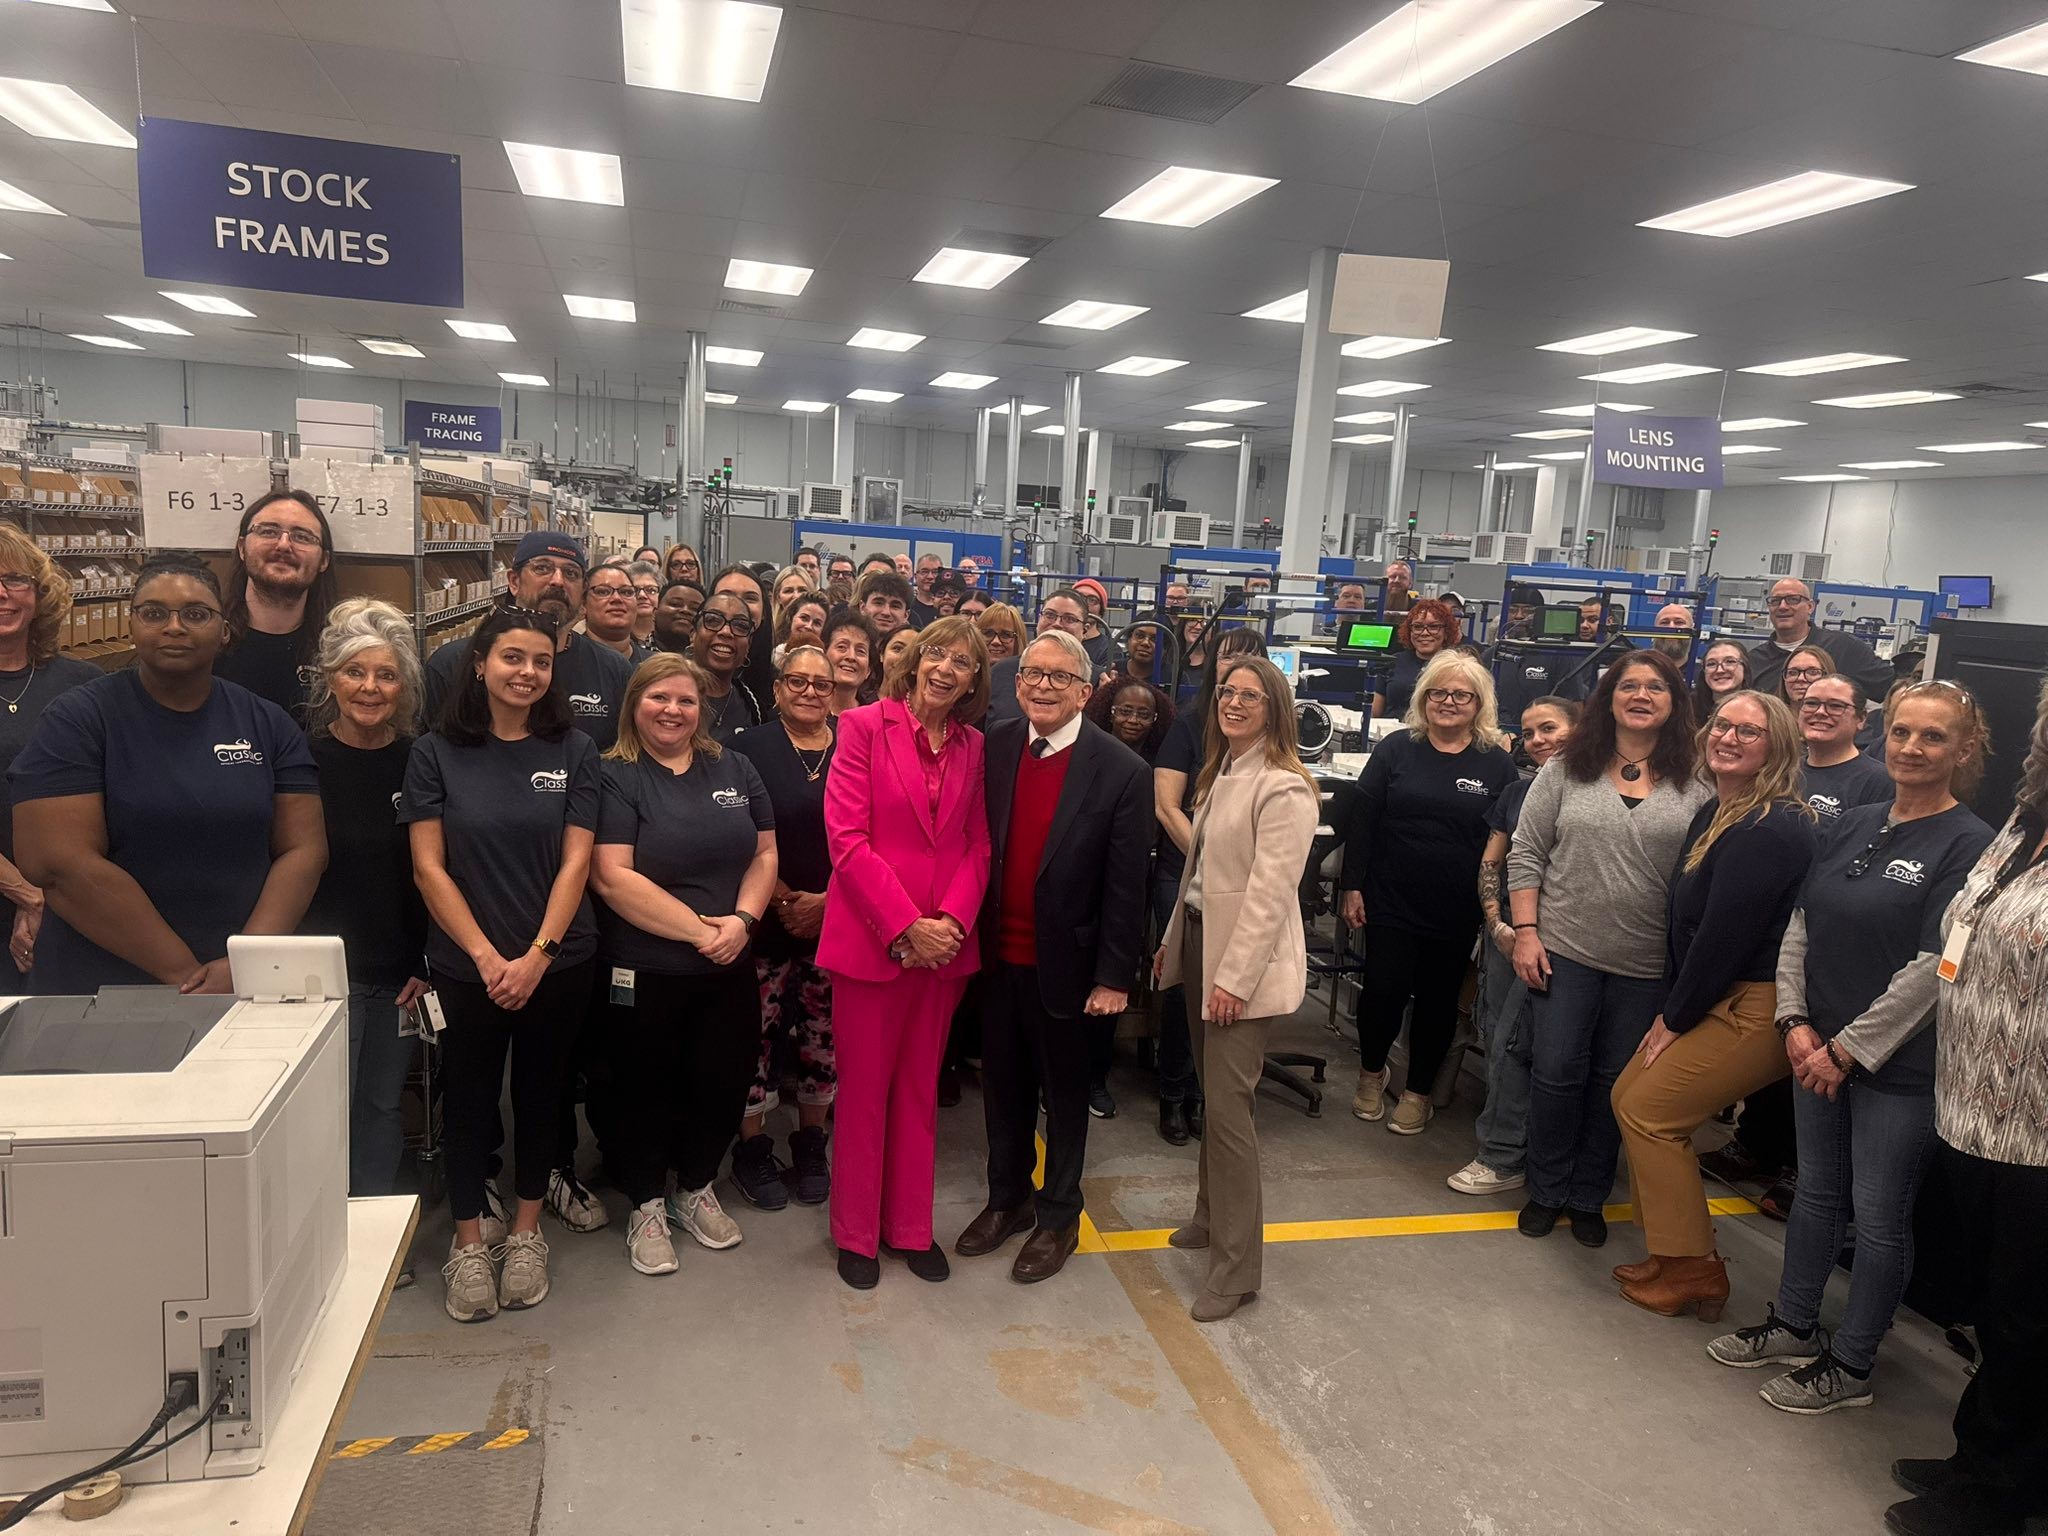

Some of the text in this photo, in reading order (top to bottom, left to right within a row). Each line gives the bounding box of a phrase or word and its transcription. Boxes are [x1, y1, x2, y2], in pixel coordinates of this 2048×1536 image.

[227, 161, 373, 210] STOCK
[214, 215, 391, 266] FRAMES
[431, 412, 477, 426] FRAME
[423, 427, 483, 442] TRACING
[1628, 427, 1674, 447] LENS
[1606, 448, 1705, 473] MOUNTING
[167, 490, 245, 512] F6 1-3
[315, 494, 389, 517] F7 1-3
[571, 701, 609, 713] Classic
[1456, 782, 1490, 794] Classic
[1807, 799, 1843, 816] Classic
